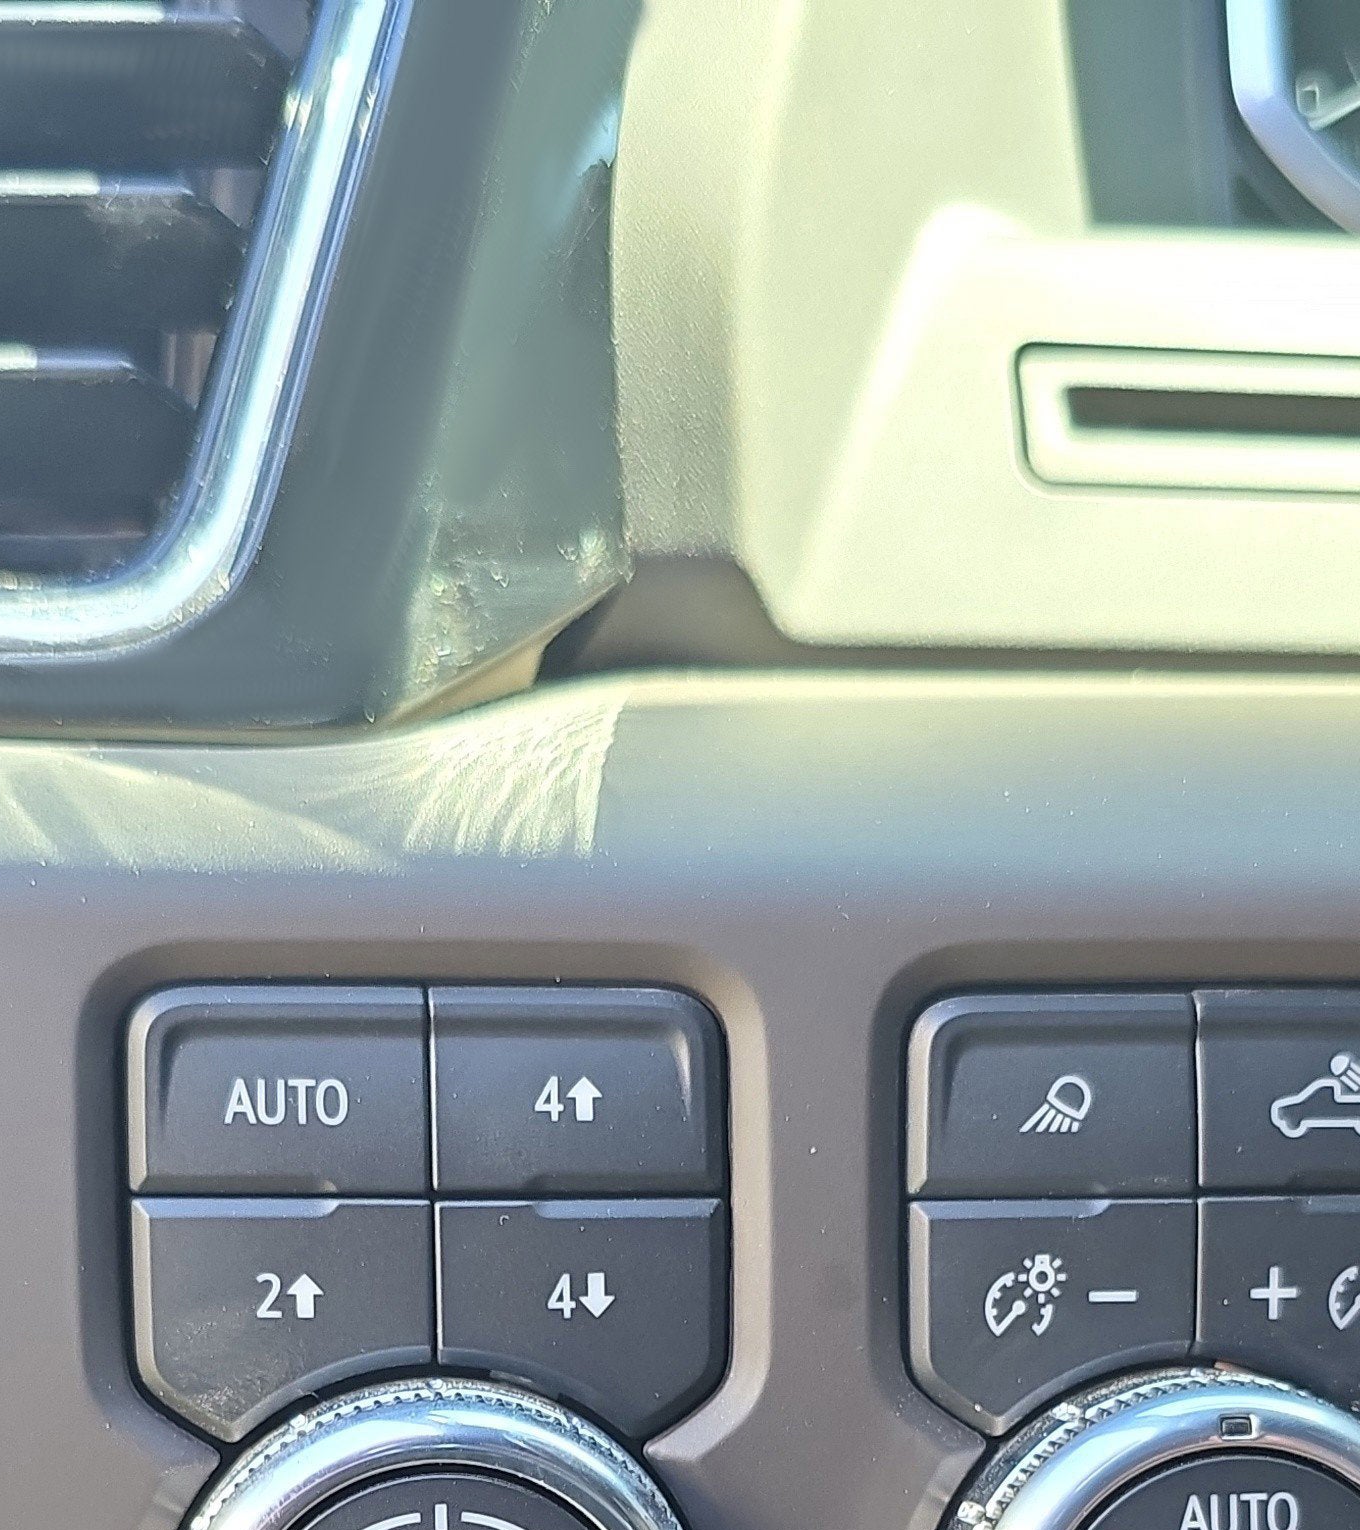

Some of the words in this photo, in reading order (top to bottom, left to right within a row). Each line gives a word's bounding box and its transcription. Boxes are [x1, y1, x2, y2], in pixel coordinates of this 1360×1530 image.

[223, 1078, 349, 1126] AUTO
[534, 1076, 564, 1122] 4
[256, 1273, 283, 1319] 2
[547, 1274, 576, 1319] 4
